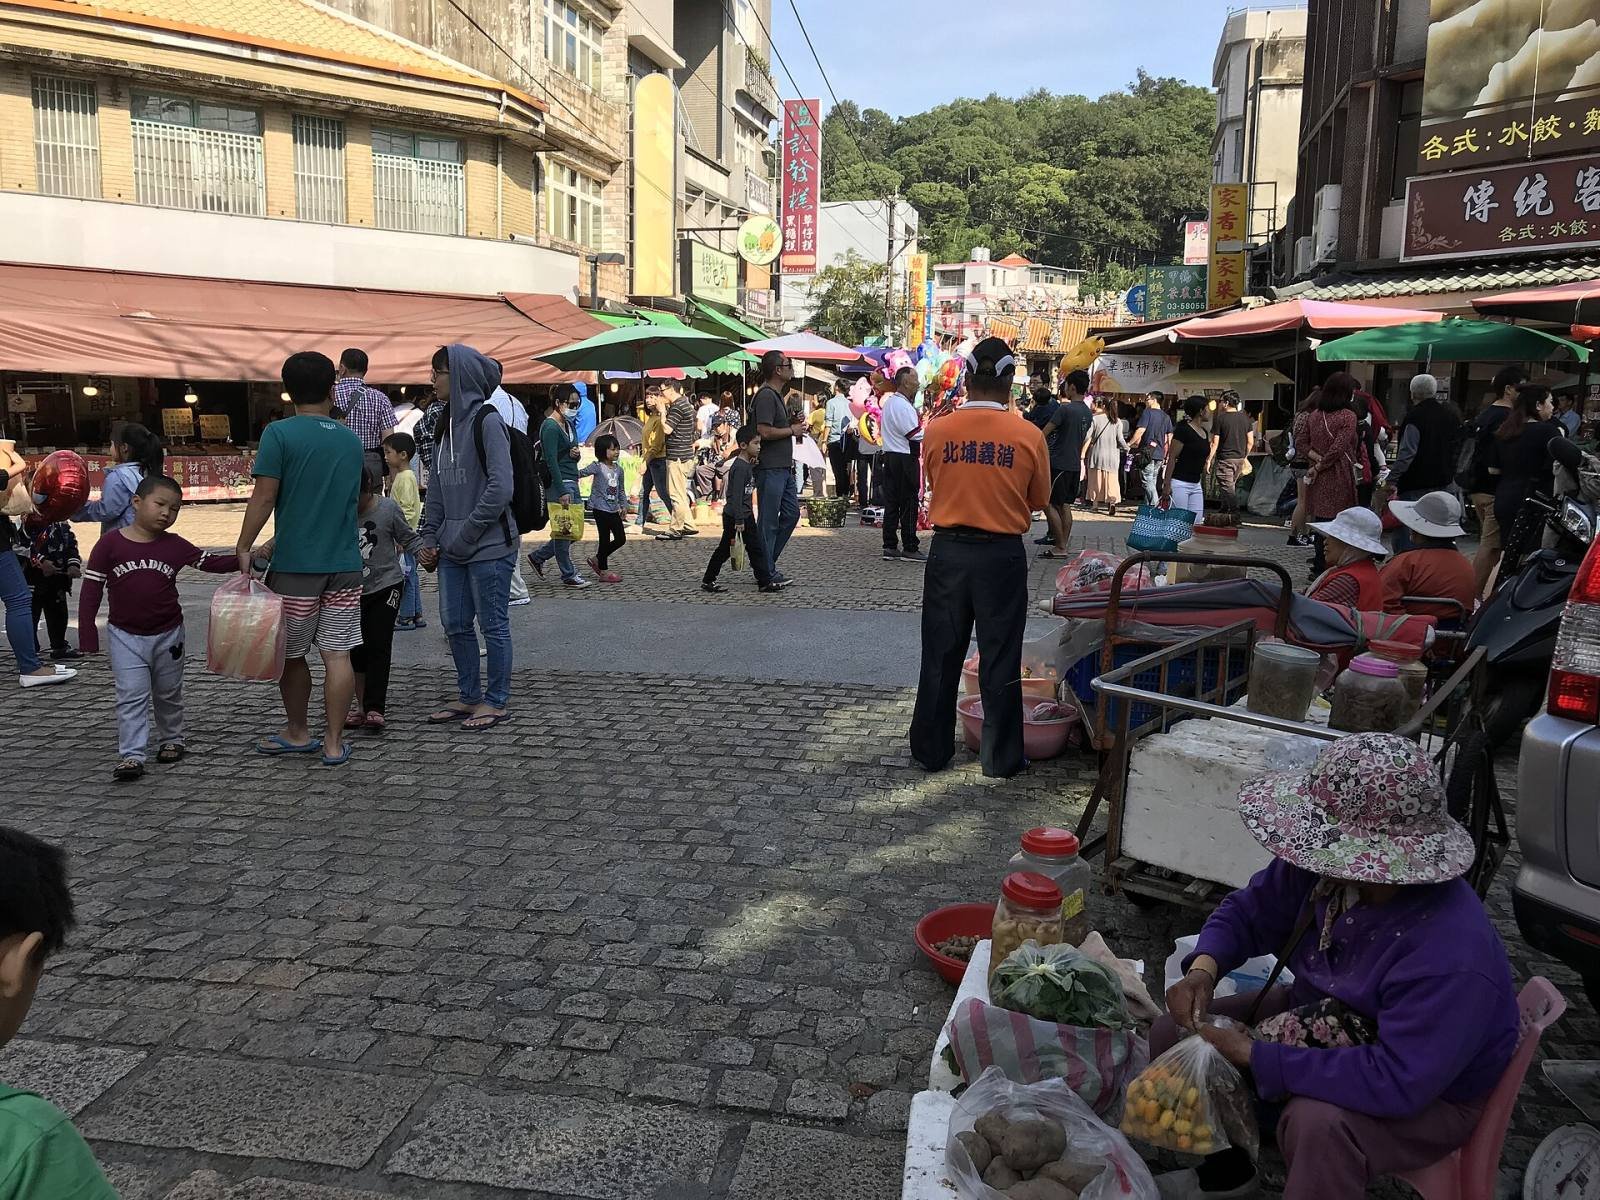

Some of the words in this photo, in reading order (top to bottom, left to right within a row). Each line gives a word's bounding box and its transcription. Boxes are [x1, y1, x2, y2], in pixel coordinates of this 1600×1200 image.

[1463, 166, 1600, 223] 傳統客
[943, 441, 1015, 469] 北埔義消
[112, 559, 175, 579] PARADISE
